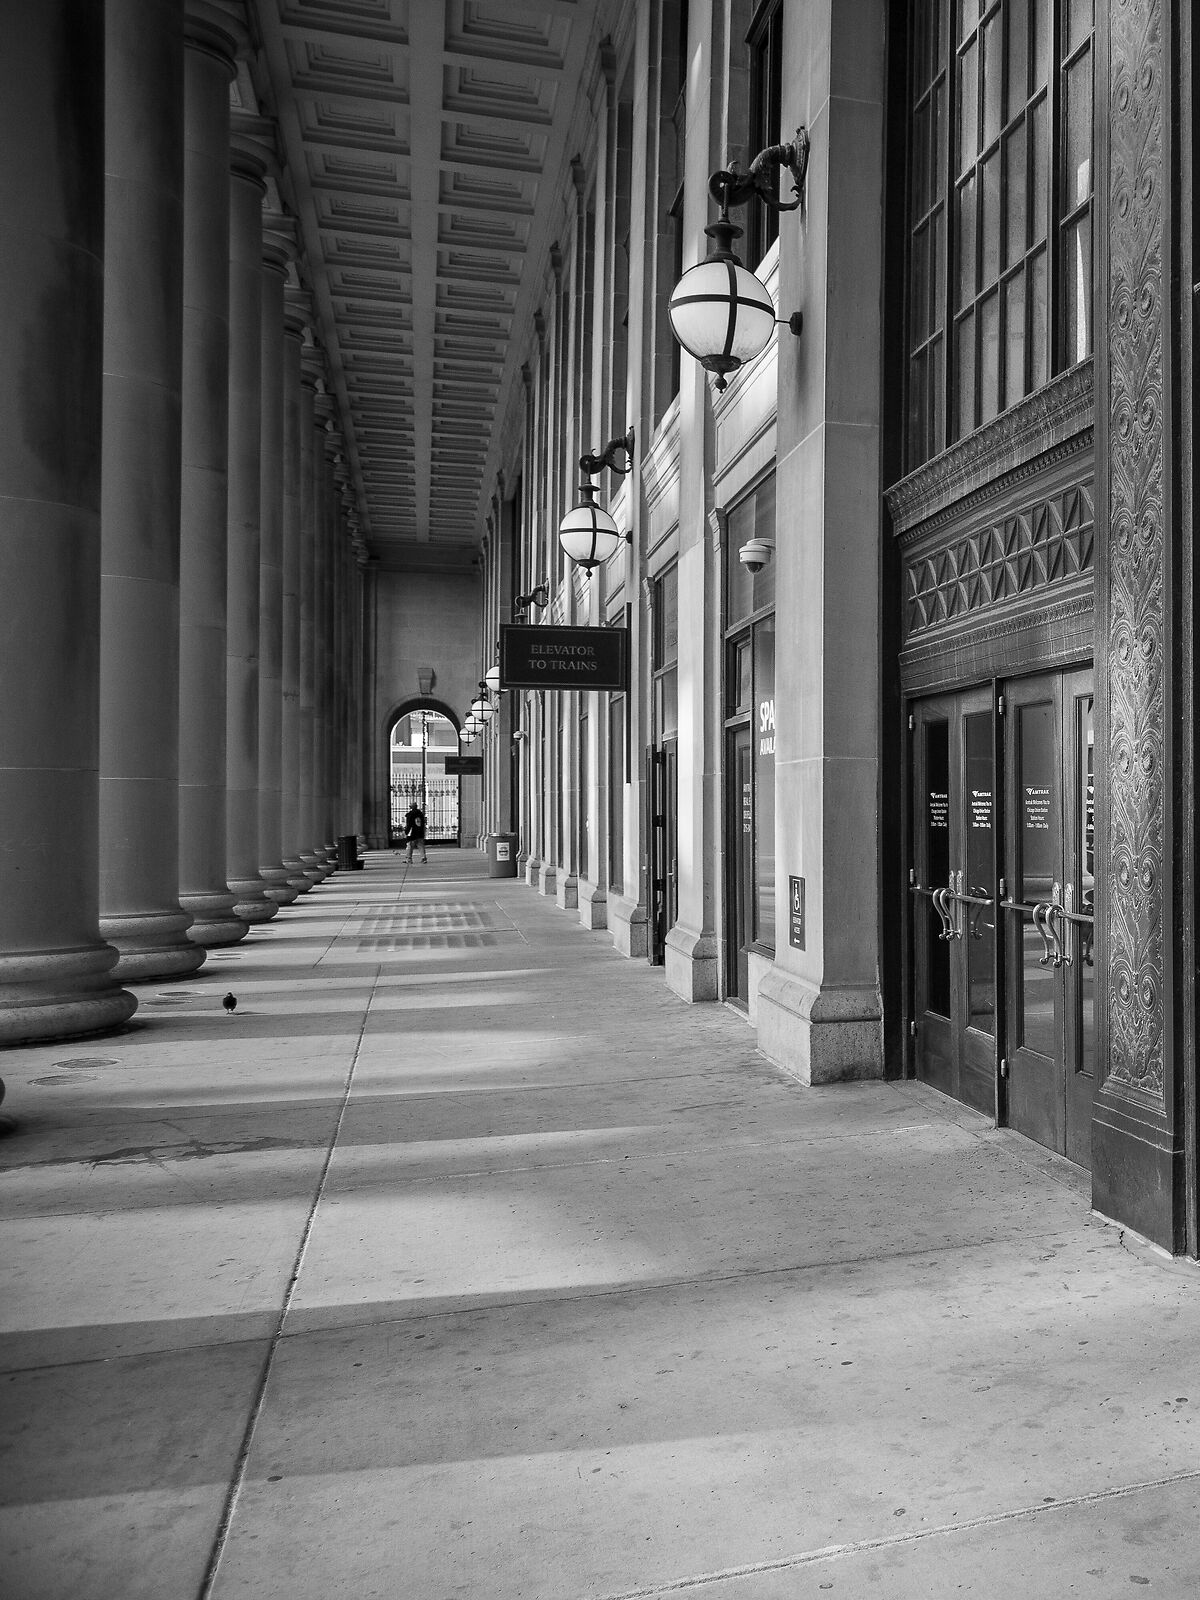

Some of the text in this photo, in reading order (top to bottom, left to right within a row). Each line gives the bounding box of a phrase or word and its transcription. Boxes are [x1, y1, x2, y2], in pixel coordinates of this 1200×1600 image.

[531, 645, 595, 656] ELEVATOR
[528, 660, 598, 671] TO TRAINS
